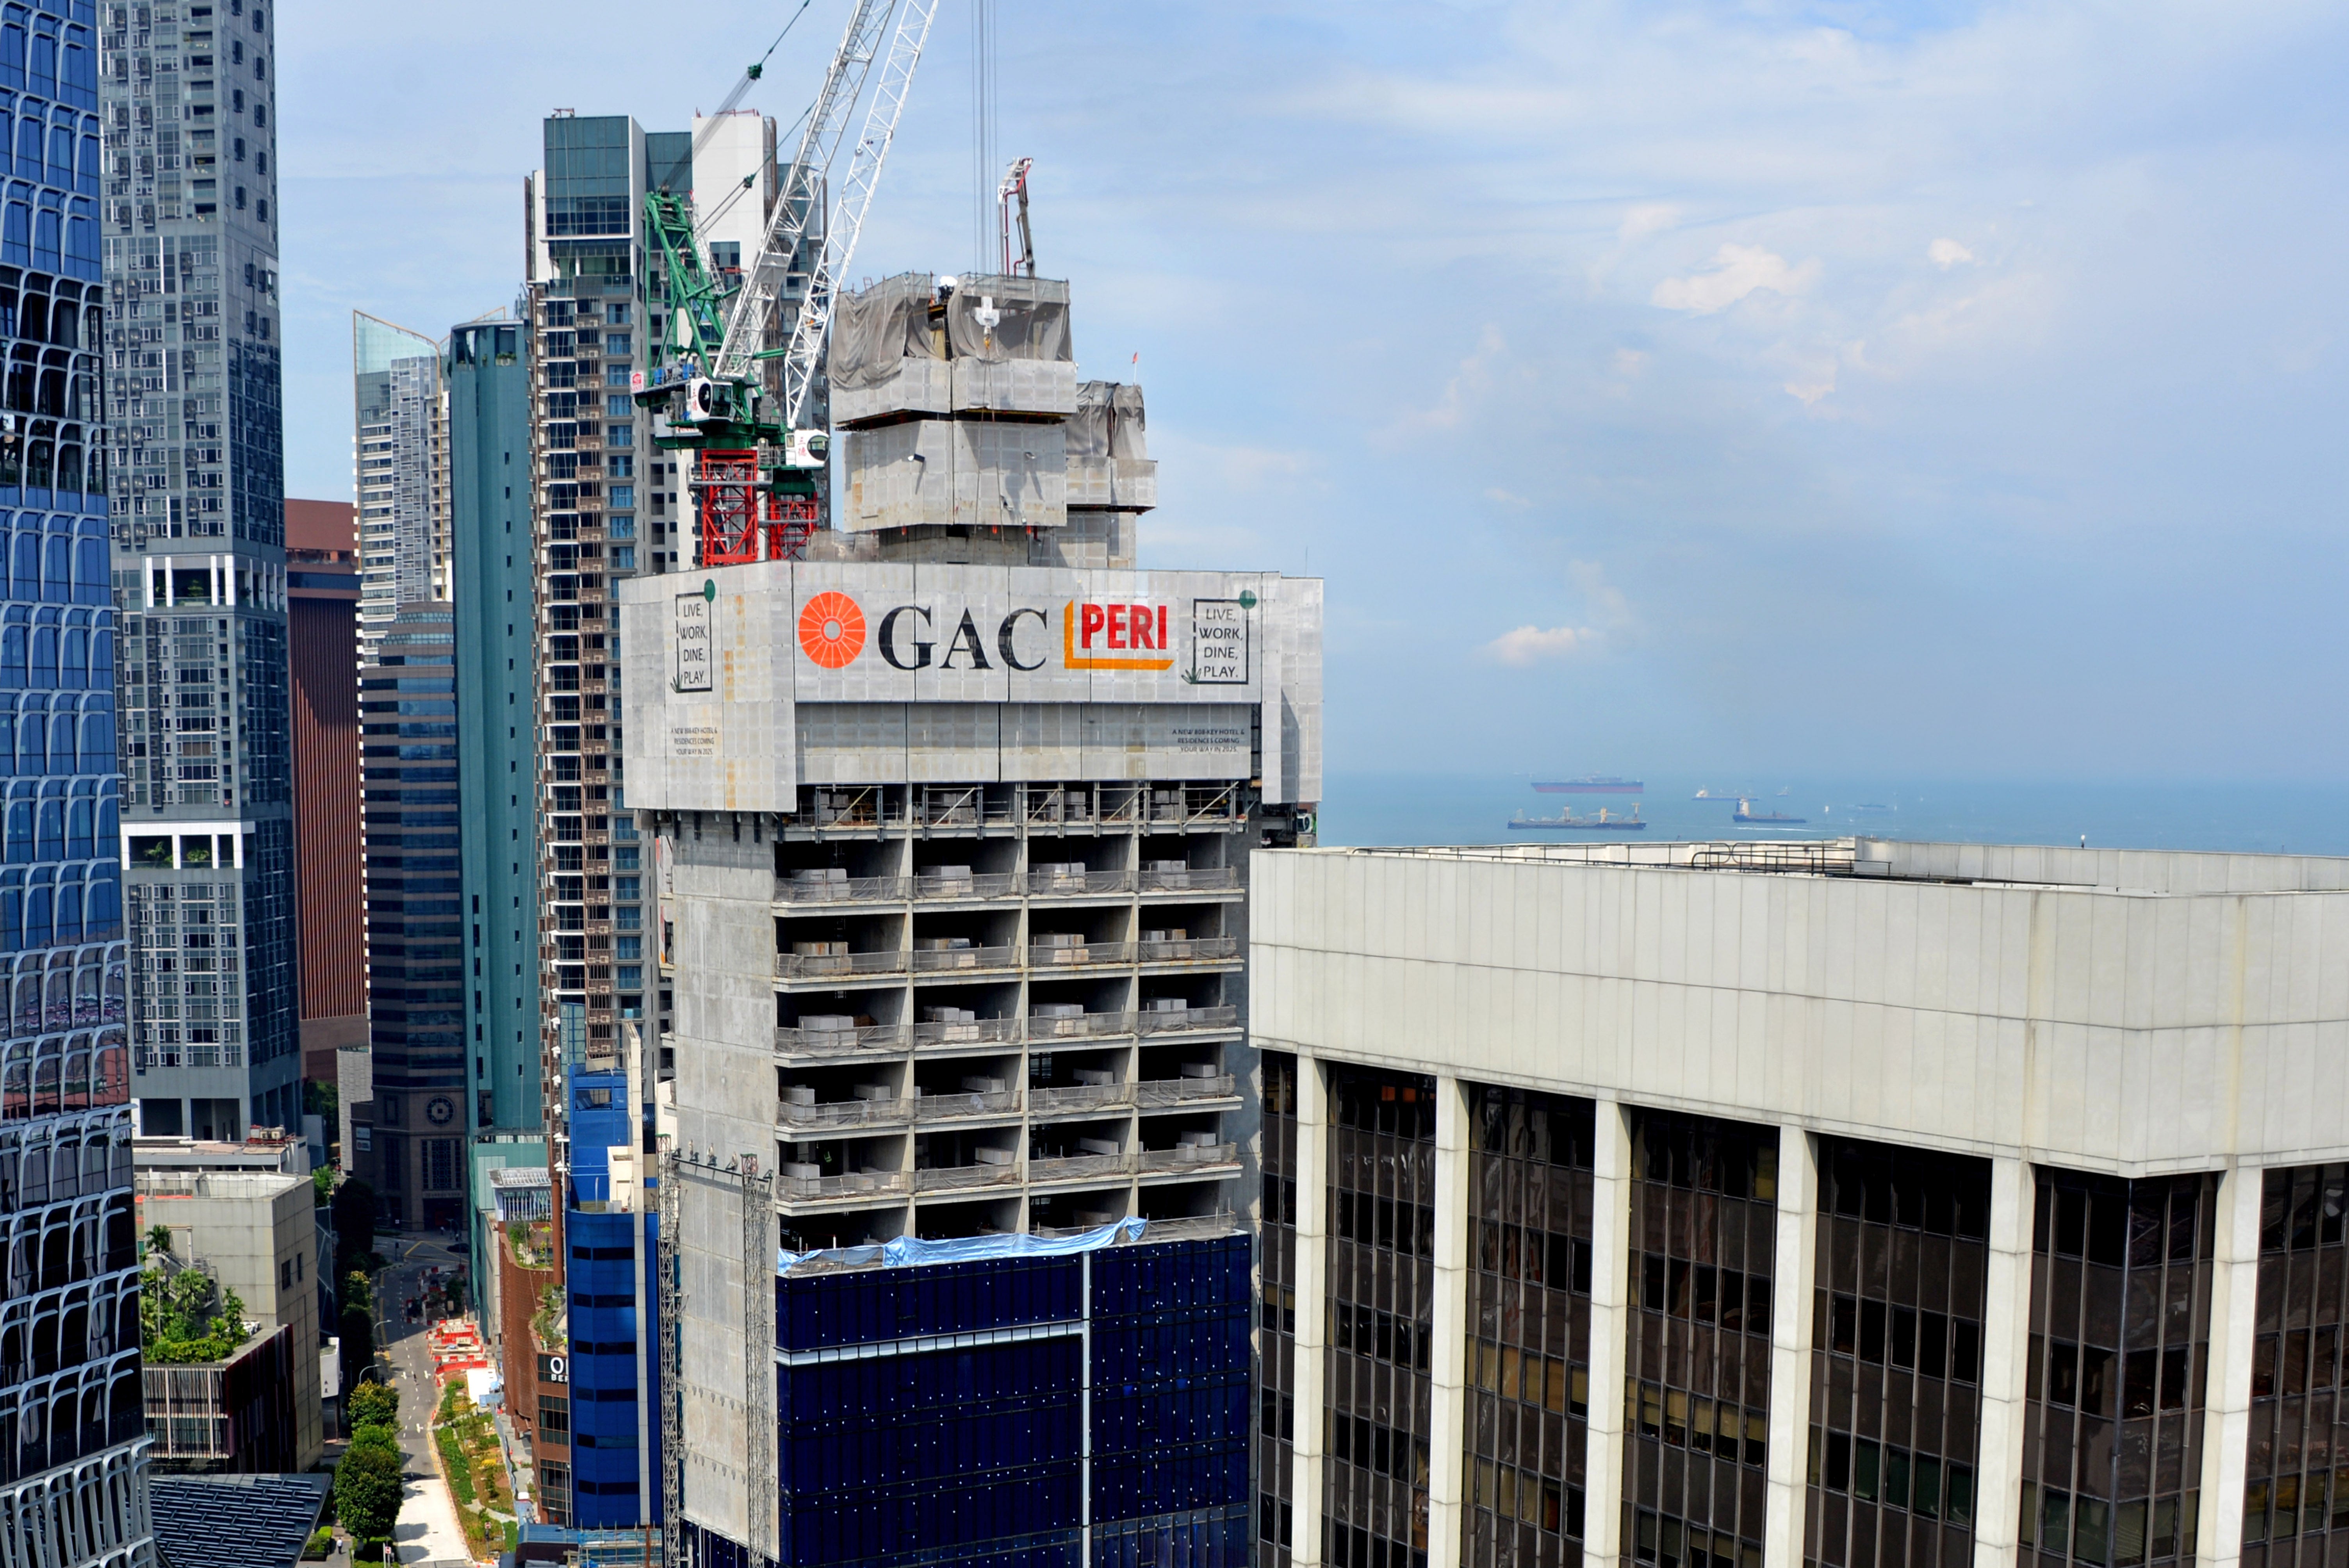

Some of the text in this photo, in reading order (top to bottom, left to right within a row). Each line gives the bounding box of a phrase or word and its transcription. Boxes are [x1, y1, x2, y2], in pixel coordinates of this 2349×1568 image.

[683, 604, 703, 617] LIVE,
[1206, 608, 1236, 622] LIVE,
[680, 625, 708, 640] WORK,
[1081, 604, 1167, 649] PERI
[878, 605, 1048, 671] GAC
[1199, 627, 1243, 641] WORK,
[684, 648, 705, 662] DINE,
[1204, 647, 1238, 660] DINE,
[684, 671, 706, 684] PLAY.
[1204, 666, 1238, 678] PLAY.
[550, 1357, 569, 1375] O
